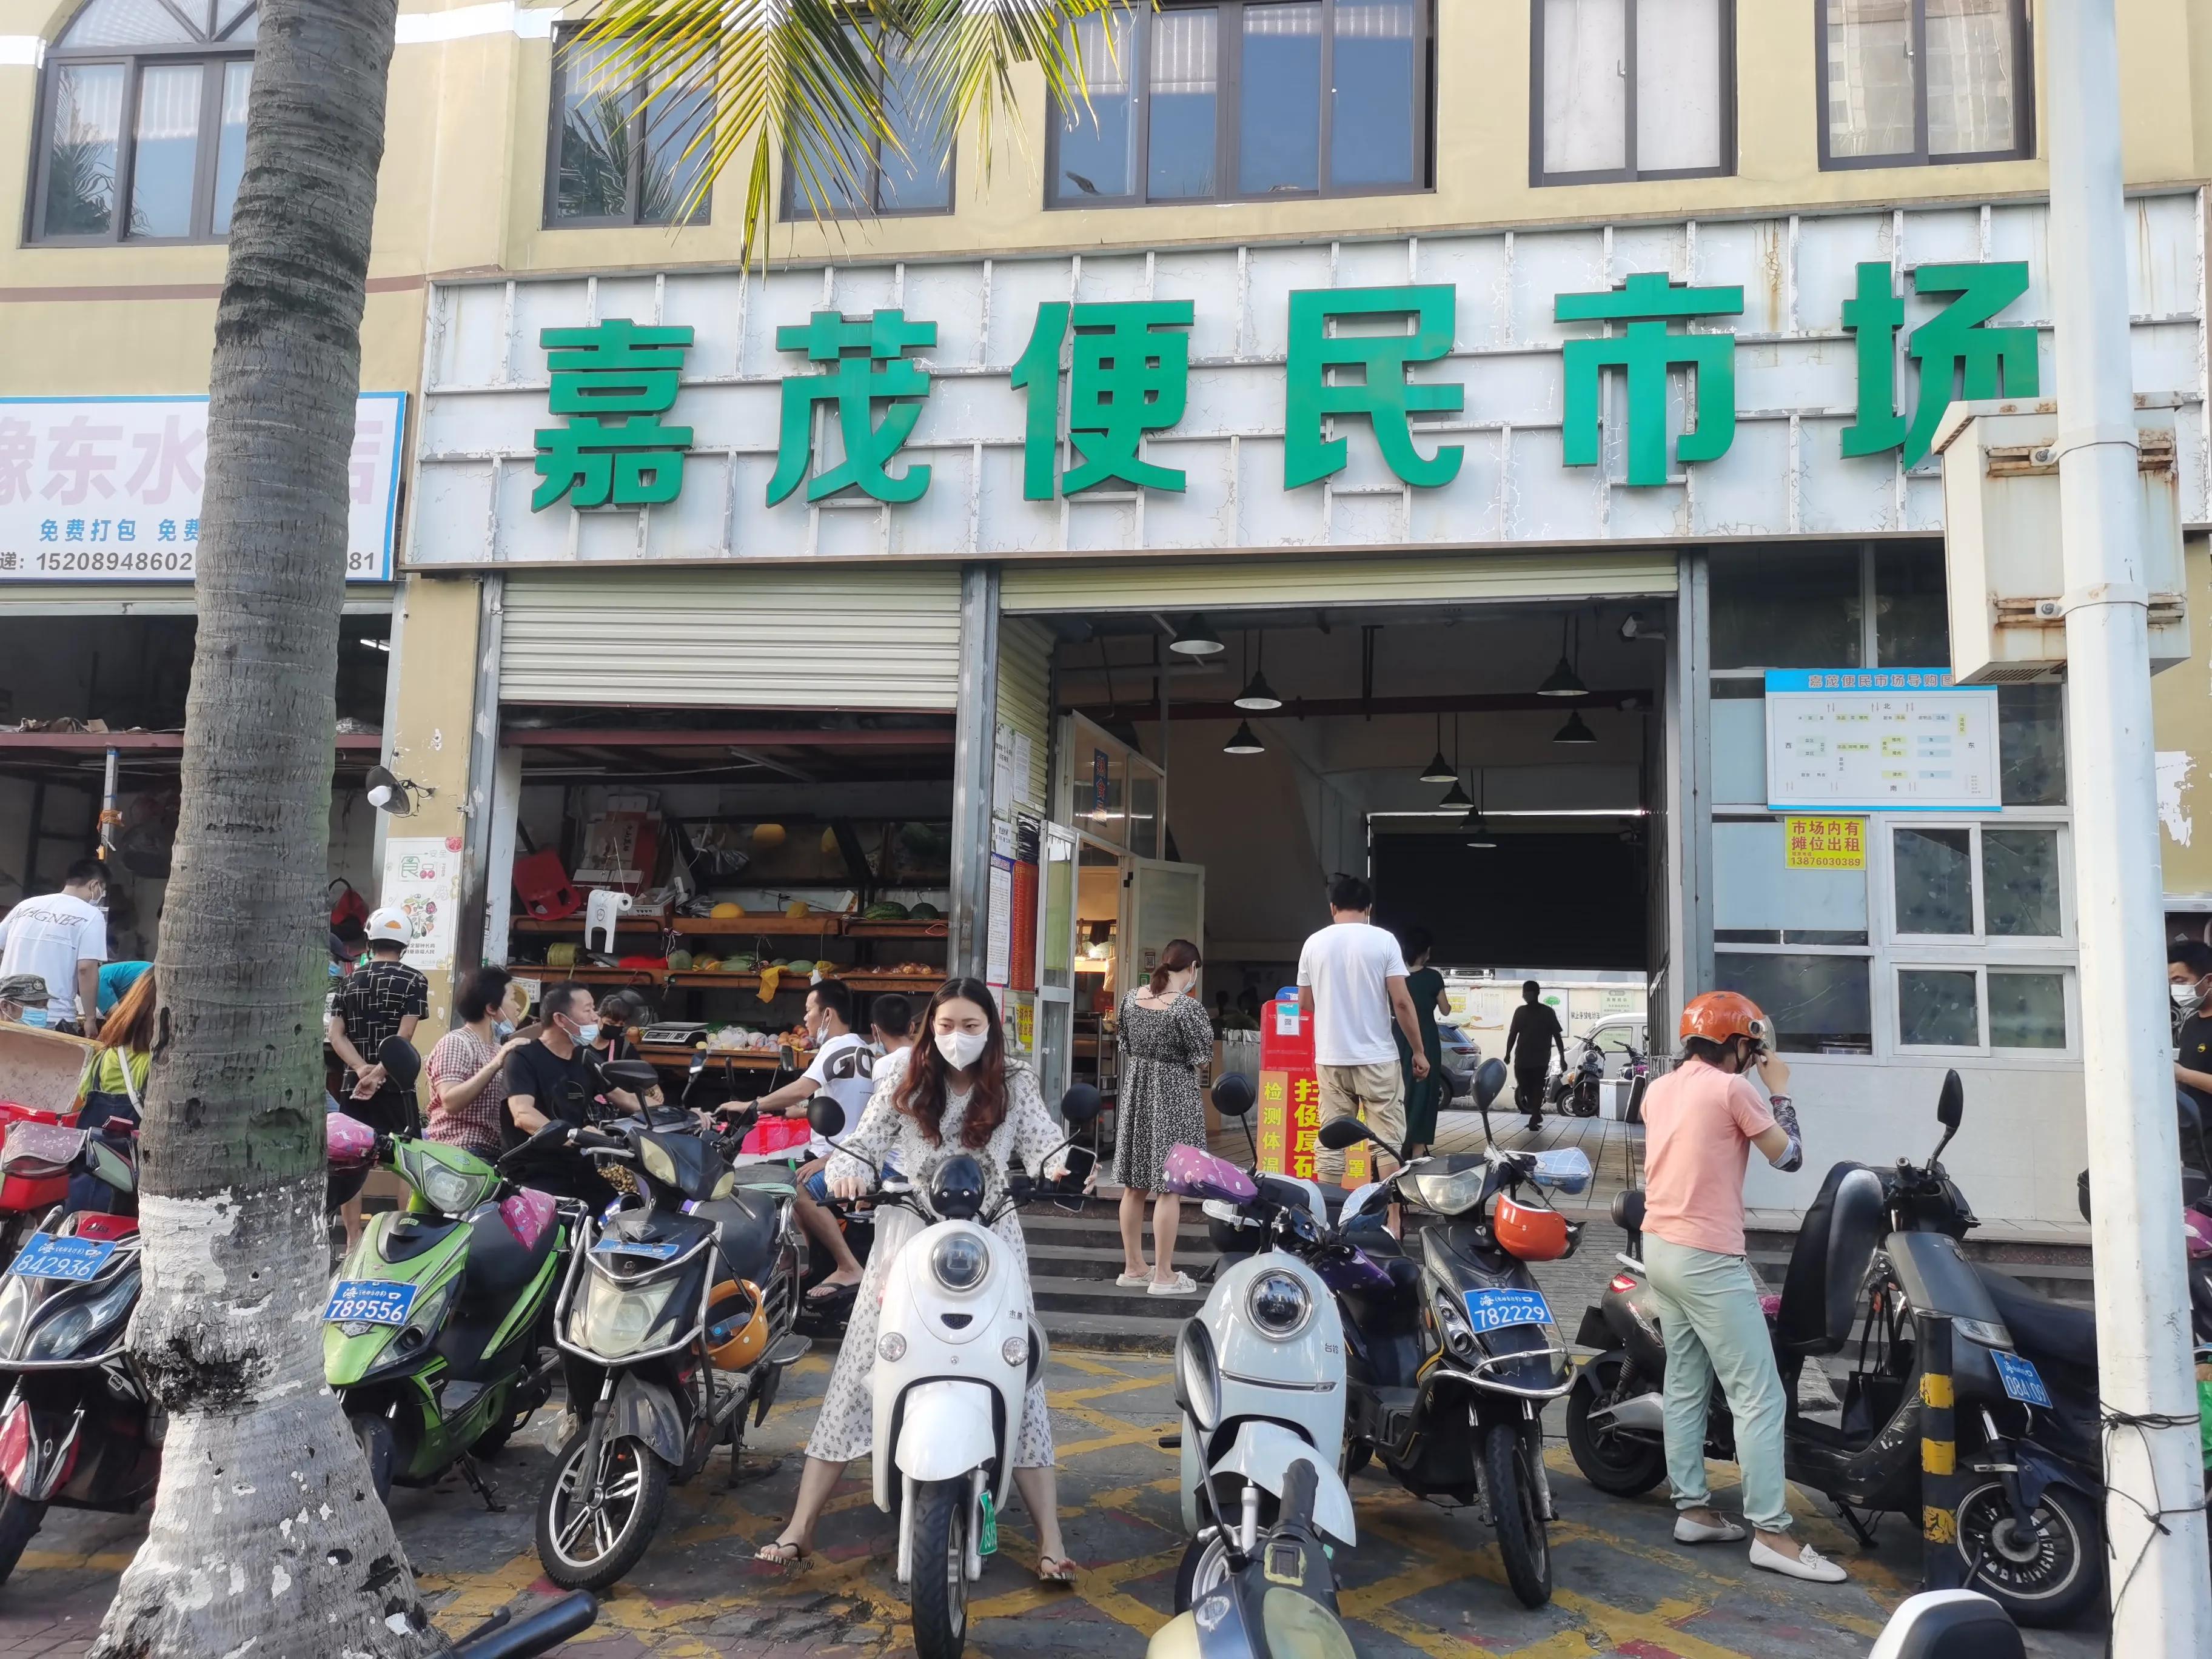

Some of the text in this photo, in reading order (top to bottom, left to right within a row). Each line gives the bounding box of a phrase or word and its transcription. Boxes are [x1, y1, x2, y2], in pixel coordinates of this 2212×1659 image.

[532, 261, 2040, 512] 嘉茂便民市场
[39, 519, 136, 541] 免费打包
[1809, 674, 1952, 688] 嘉茂便民市场导购图
[1792, 820, 1860, 836] 市场内有
[1791, 836, 1860, 851] 摊位出租
[401, 856, 435, 879] 食品
[1791, 857, 1860, 866] 13876030389
[10, 907, 89, 926] MAGNET
[1262, 1082, 1282, 1174] 检测体温
[16, 1255, 95, 1276] 842936
[329, 1300, 404, 1321] 789556
[1474, 1305, 1545, 1328] 782229
